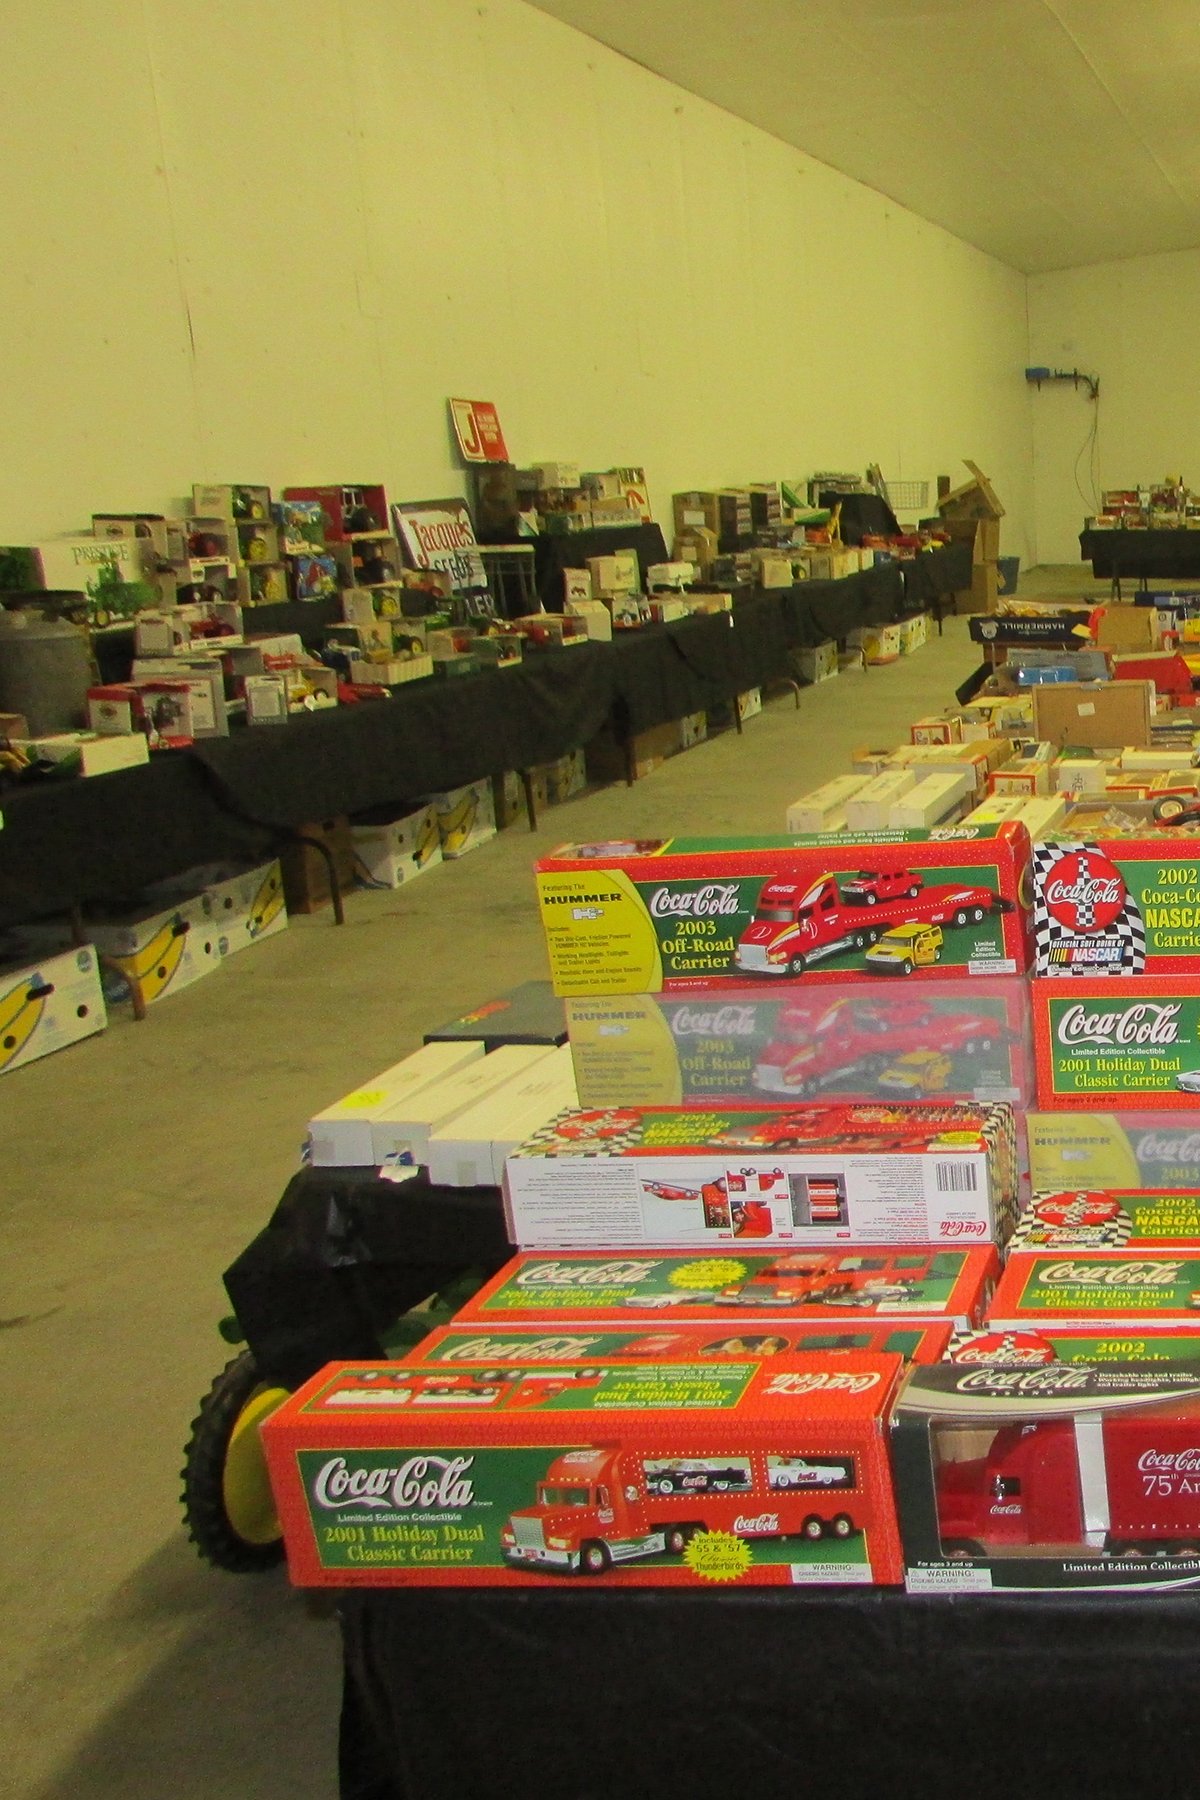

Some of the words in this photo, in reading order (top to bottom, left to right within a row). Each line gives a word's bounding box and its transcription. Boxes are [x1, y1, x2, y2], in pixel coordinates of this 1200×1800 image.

[409, 518, 474, 568] Jacques
[1001, 622, 1065, 632] HAMMERMILL
[1158, 868, 1198, 884] 2002
[1047, 878, 1121, 904] Coca-Cola
[544, 893, 622, 905] HUMMER
[651, 884, 740, 917] Coca-Cola
[676, 921, 716, 936] 2003
[662, 937, 735, 954] Off-Road
[1052, 940, 1081, 948] OFFICIAL
[1072, 948, 1120, 961] NASCAR
[671, 956, 730, 970] Carrier
[672, 1006, 756, 1034] Coca-Cola
[1058, 1003, 1182, 1045] Coca-Cola
[683, 1056, 750, 1071] Off-Road
[1059, 1059, 1091, 1072] 2001
[1096, 1058, 1146, 1074] Holiday
[1150, 1058, 1181, 1071] Dual
[690, 1072, 746, 1087] Carrier
[1075, 1074, 1118, 1088] Classic
[1123, 1074, 1170, 1087] Carrier
[1155, 1198, 1196, 1207] 2002
[1039, 1261, 1185, 1284] Coca-Cola
[1031, 1290, 1068, 1299] 2001
[1074, 1290, 1134, 1299] Holiday
[1139, 1290, 1175, 1299] Dual
[1046, 1299, 1100, 1307] Classic
[1104, 1299, 1161, 1307] Carrier
[1096, 1341, 1146, 1353] 2002
[956, 1348, 1050, 1363] Coca-Cola
[760, 1372, 880, 1394] Coca-Cola
[956, 1366, 1097, 1391] Coca-Cola
[315, 1456, 474, 1508] Coca-Cola
[990, 1504, 1022, 1515] Coca-Cola
[338, 1514, 373, 1522] Limited
[412, 1513, 462, 1521] Collectible
[734, 1513, 780, 1532] Coca-Cola
[325, 1527, 366, 1542] 2001
[372, 1525, 439, 1545] Holiday
[445, 1524, 484, 1541] Dual
[348, 1546, 406, 1561] Classic
[411, 1545, 473, 1560] Carrier
[692, 1544, 710, 1552] '55
[713, 1544, 722, 1552] &
[725, 1544, 740, 1552] '57
[696, 1562, 744, 1570] Thunderbirds
[1063, 1563, 1105, 1572] Limited
[1107, 1562, 1148, 1571] Edition
